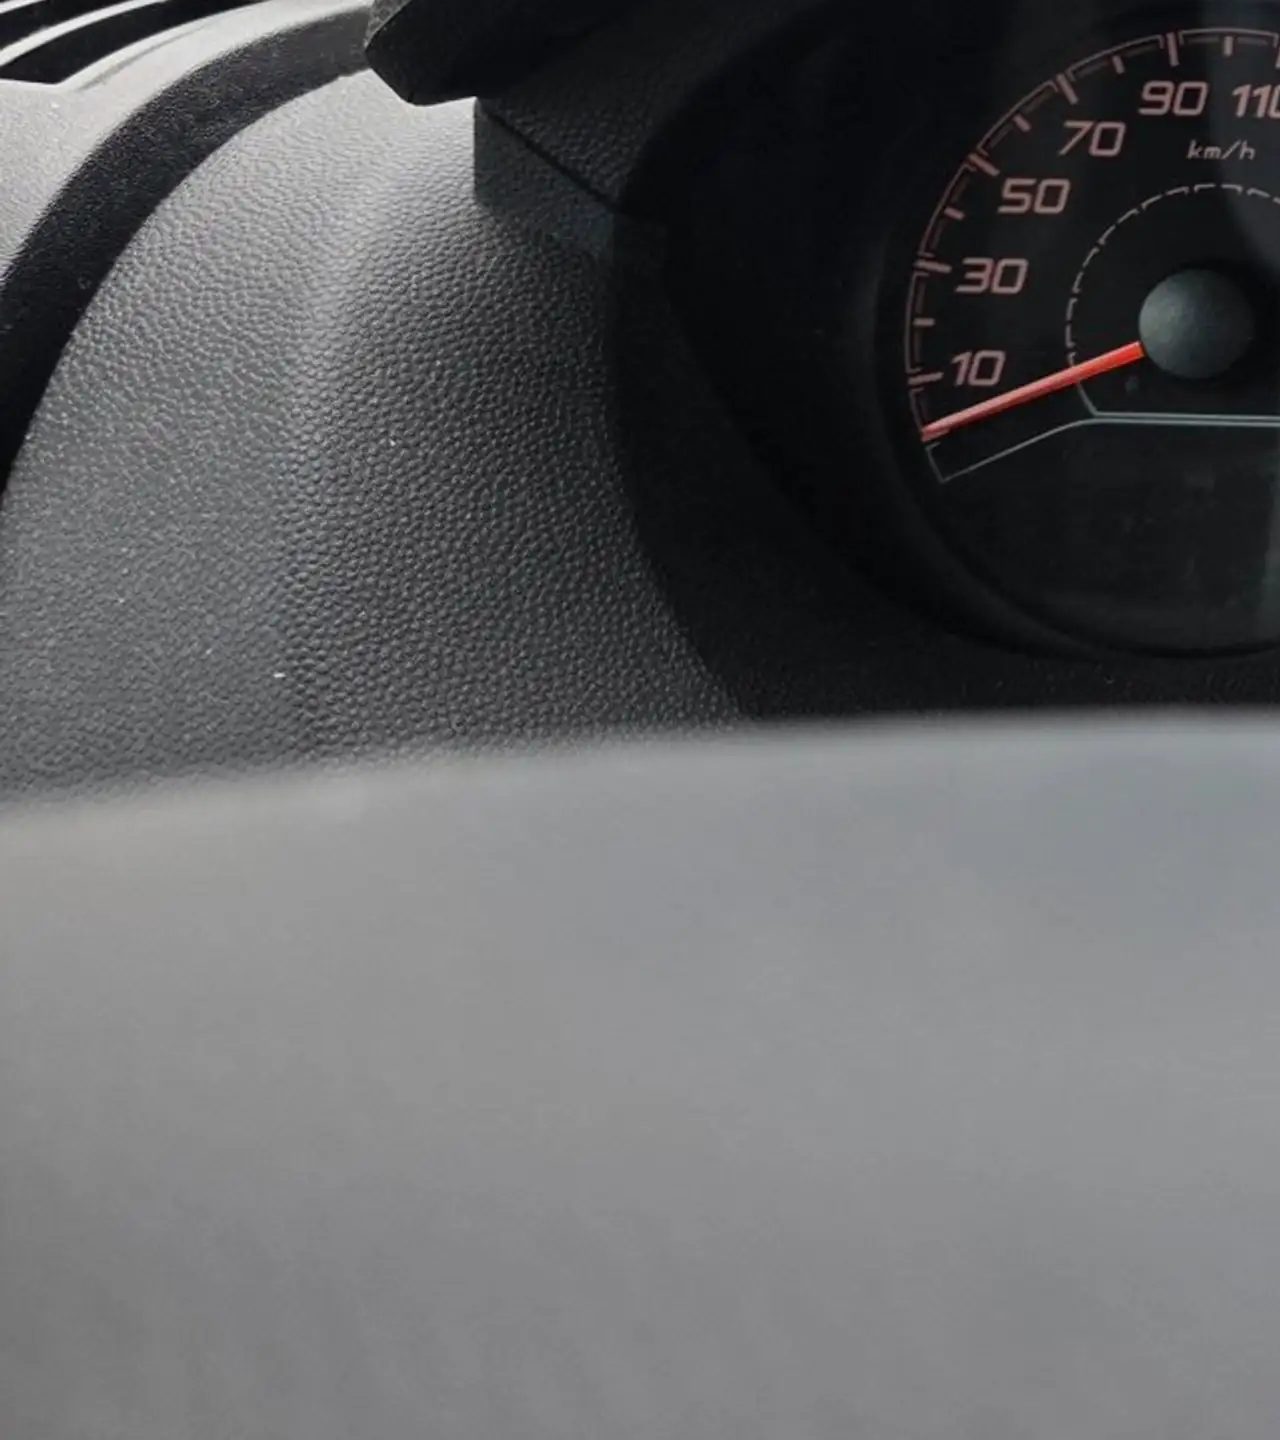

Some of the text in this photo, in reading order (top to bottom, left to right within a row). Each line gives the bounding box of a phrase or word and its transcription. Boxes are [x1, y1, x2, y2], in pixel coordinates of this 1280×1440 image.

[1139, 81, 1208, 115] 90
[1060, 121, 1125, 156] 70
[1188, 140, 1255, 160] km/h
[997, 177, 1071, 215] 50
[956, 257, 1028, 295] 30
[952, 350, 1005, 387] 10
